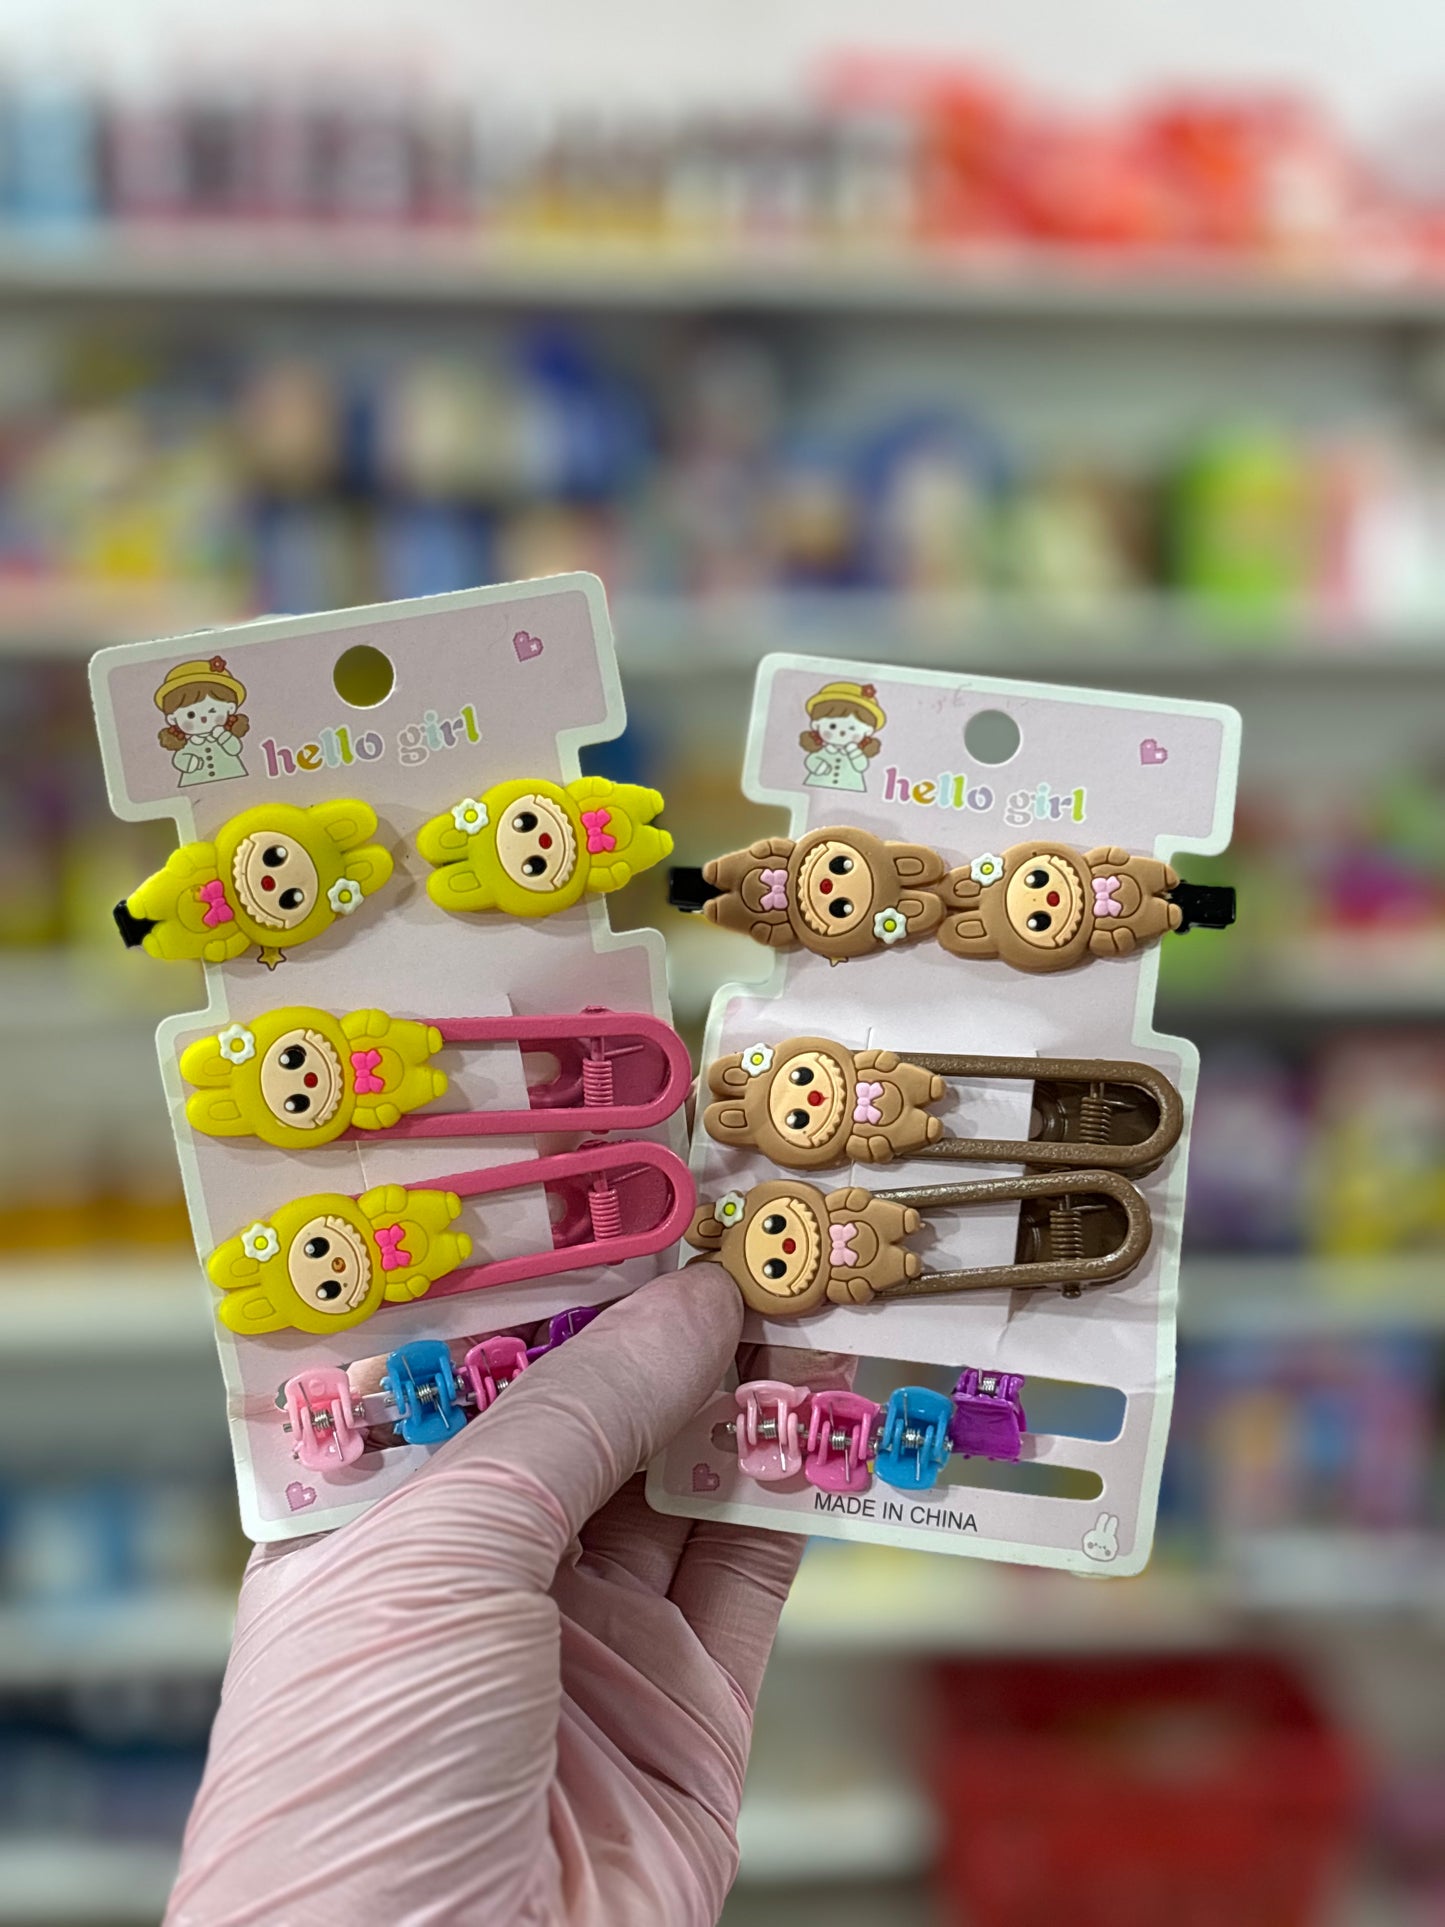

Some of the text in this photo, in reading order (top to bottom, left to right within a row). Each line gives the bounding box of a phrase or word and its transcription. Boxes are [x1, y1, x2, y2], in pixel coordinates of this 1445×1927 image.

[262, 704, 481, 777] hello girl
[883, 768, 1087, 826] hello girl
[814, 1491, 977, 1532] MADE IN CHINA
